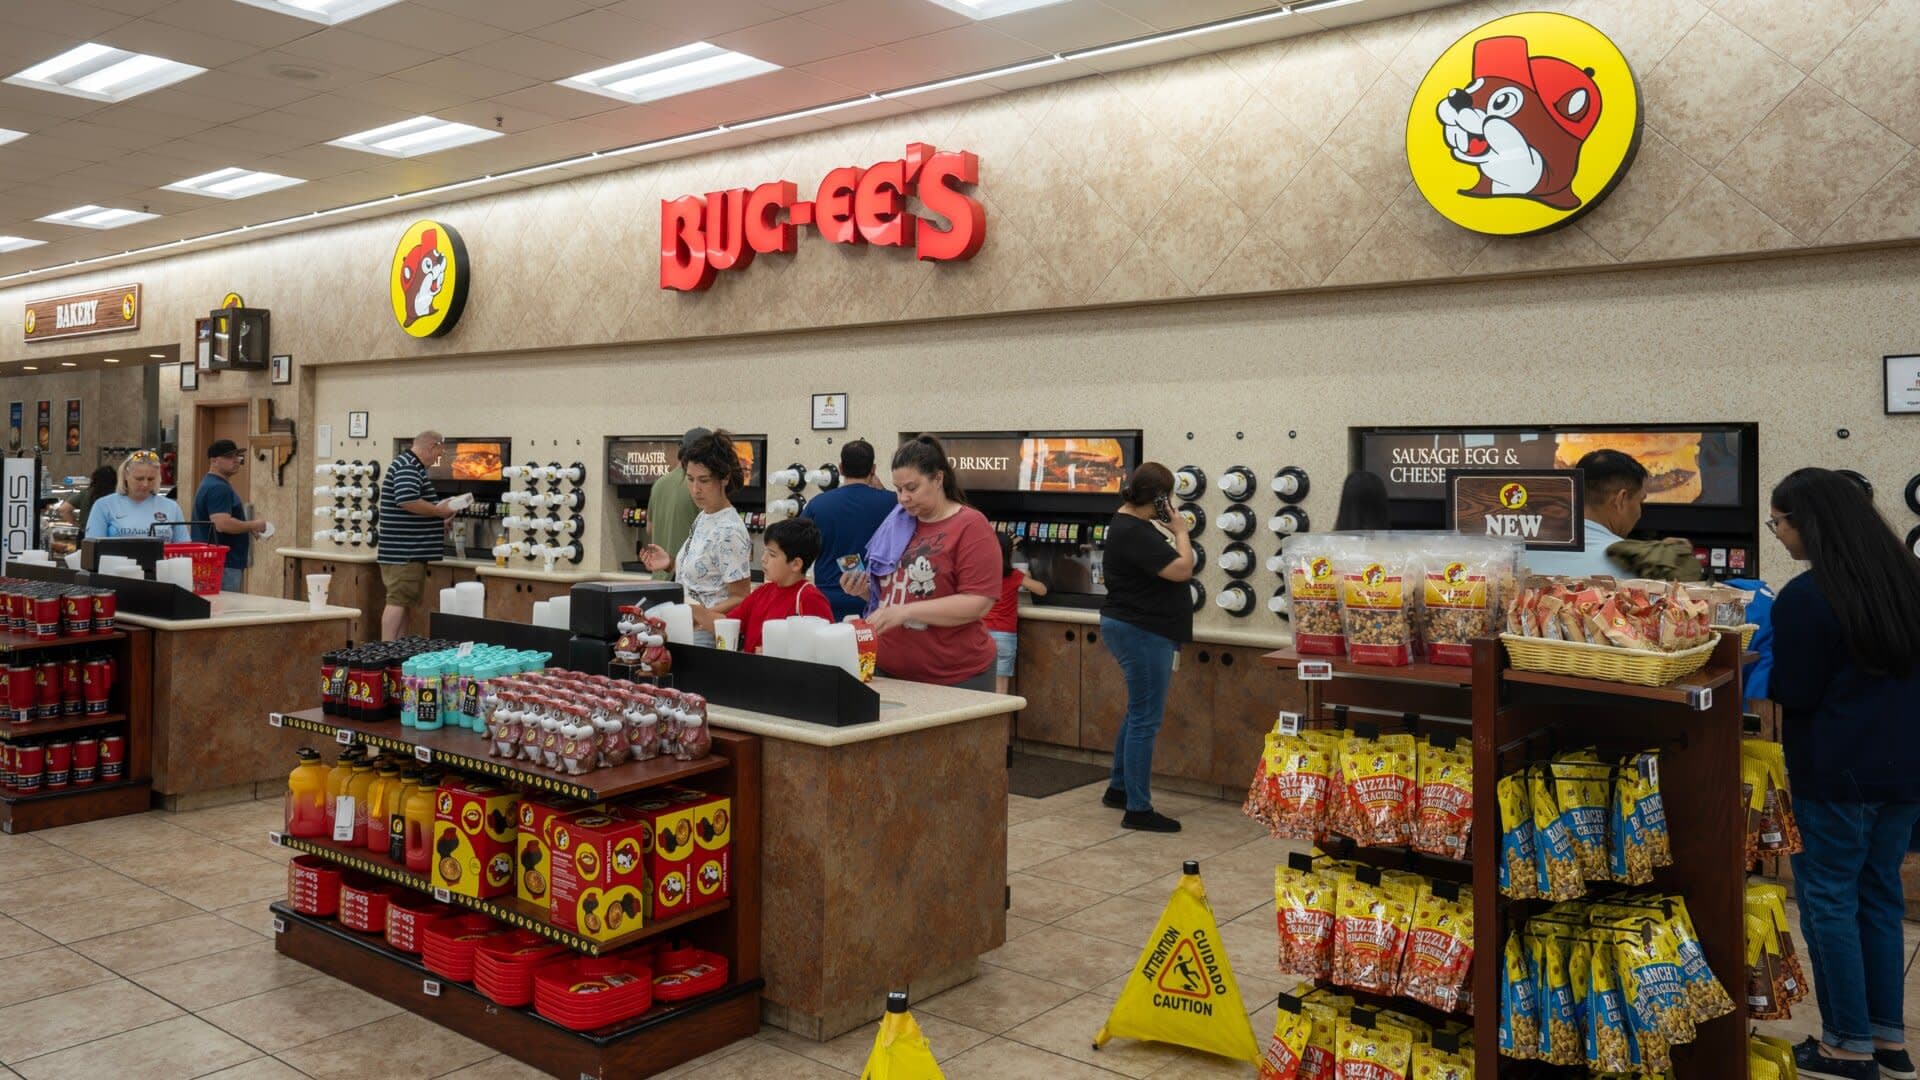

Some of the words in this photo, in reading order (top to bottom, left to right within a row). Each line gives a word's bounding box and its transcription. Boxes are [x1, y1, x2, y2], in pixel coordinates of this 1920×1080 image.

[660, 142, 987, 292] BUC-EE'S
[56, 300, 99, 329] BAKERY
[627, 451, 667, 464] PITMASTER
[959, 456, 1009, 471] BRISKET
[1392, 447, 1459, 465] SAUSAGE
[1464, 447, 1499, 465] EGG
[1504, 447, 1520, 465] &
[649, 464, 670, 476] PORK
[1390, 466, 1446, 484] CHEESE
[8, 474, 29, 560] OSIS
[1484, 513, 1543, 538] NEW
[857, 633, 874, 643] CHIPS
[1142, 925, 1180, 982] ATTENTION
[1193, 929, 1227, 995] CUIDADO
[1153, 993, 1213, 1017] CAUTION
